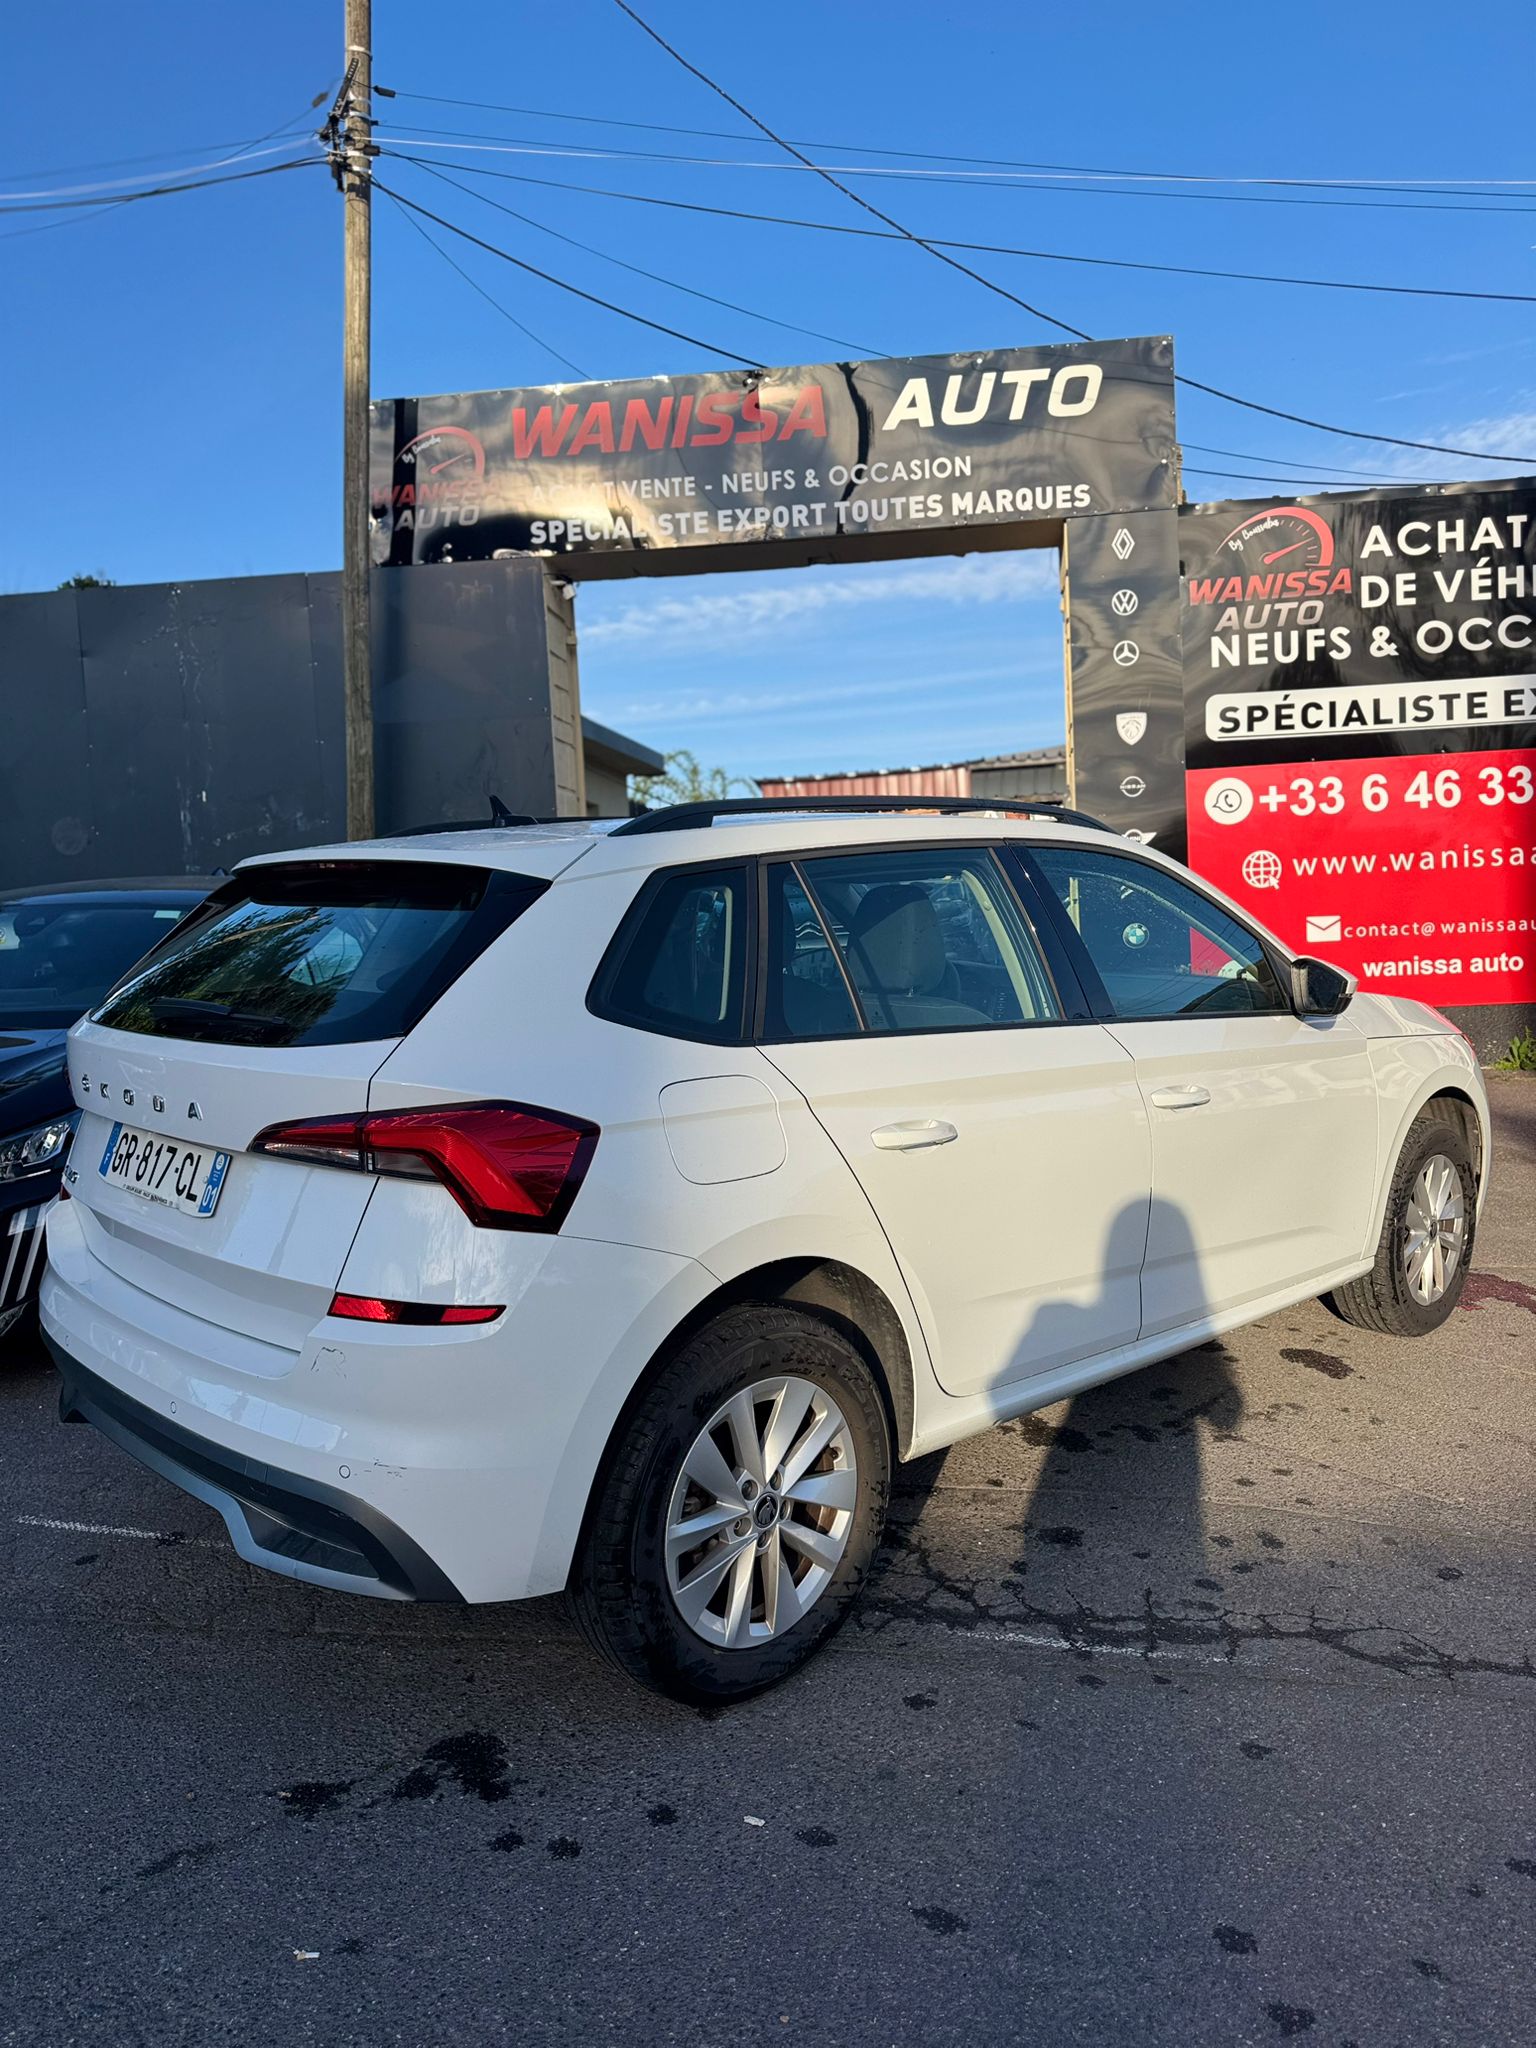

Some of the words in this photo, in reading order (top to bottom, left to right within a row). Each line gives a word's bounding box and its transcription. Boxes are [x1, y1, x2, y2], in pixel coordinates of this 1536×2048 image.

[511, 385, 828, 460] WANISSA
[882, 363, 1104, 432] AUTO
[622, 476, 696, 500] VENTE
[721, 468, 797, 494] NEUFS
[804, 468, 820, 489] &
[828, 455, 972, 487] OCCASION
[394, 504, 481, 532] AUTO
[718, 502, 827, 533] EXPORT
[834, 493, 944, 526] TOUTES
[951, 484, 1092, 517] MARQUES
[1360, 514, 1528, 559] ACHAT
[1189, 568, 1352, 606] WANISSA
[1360, 571, 1417, 608] DE
[1213, 600, 1325, 632] AUTO
[1210, 626, 1352, 669] NEUFS
[1369, 625, 1400, 658] &
[1416, 614, 1534, 655] OCC
[1218, 691, 1488, 735] SPÉCIALISTE
[1503, 686, 1536, 718] E
[1258, 776, 1346, 817] +33
[1361, 773, 1389, 813] 6
[1404, 769, 1462, 810] 46
[1478, 765, 1535, 806] 33
[1362, 955, 1463, 978] wanissa
[1469, 952, 1525, 973] auto
[202, 1184, 218, 1209] 01
